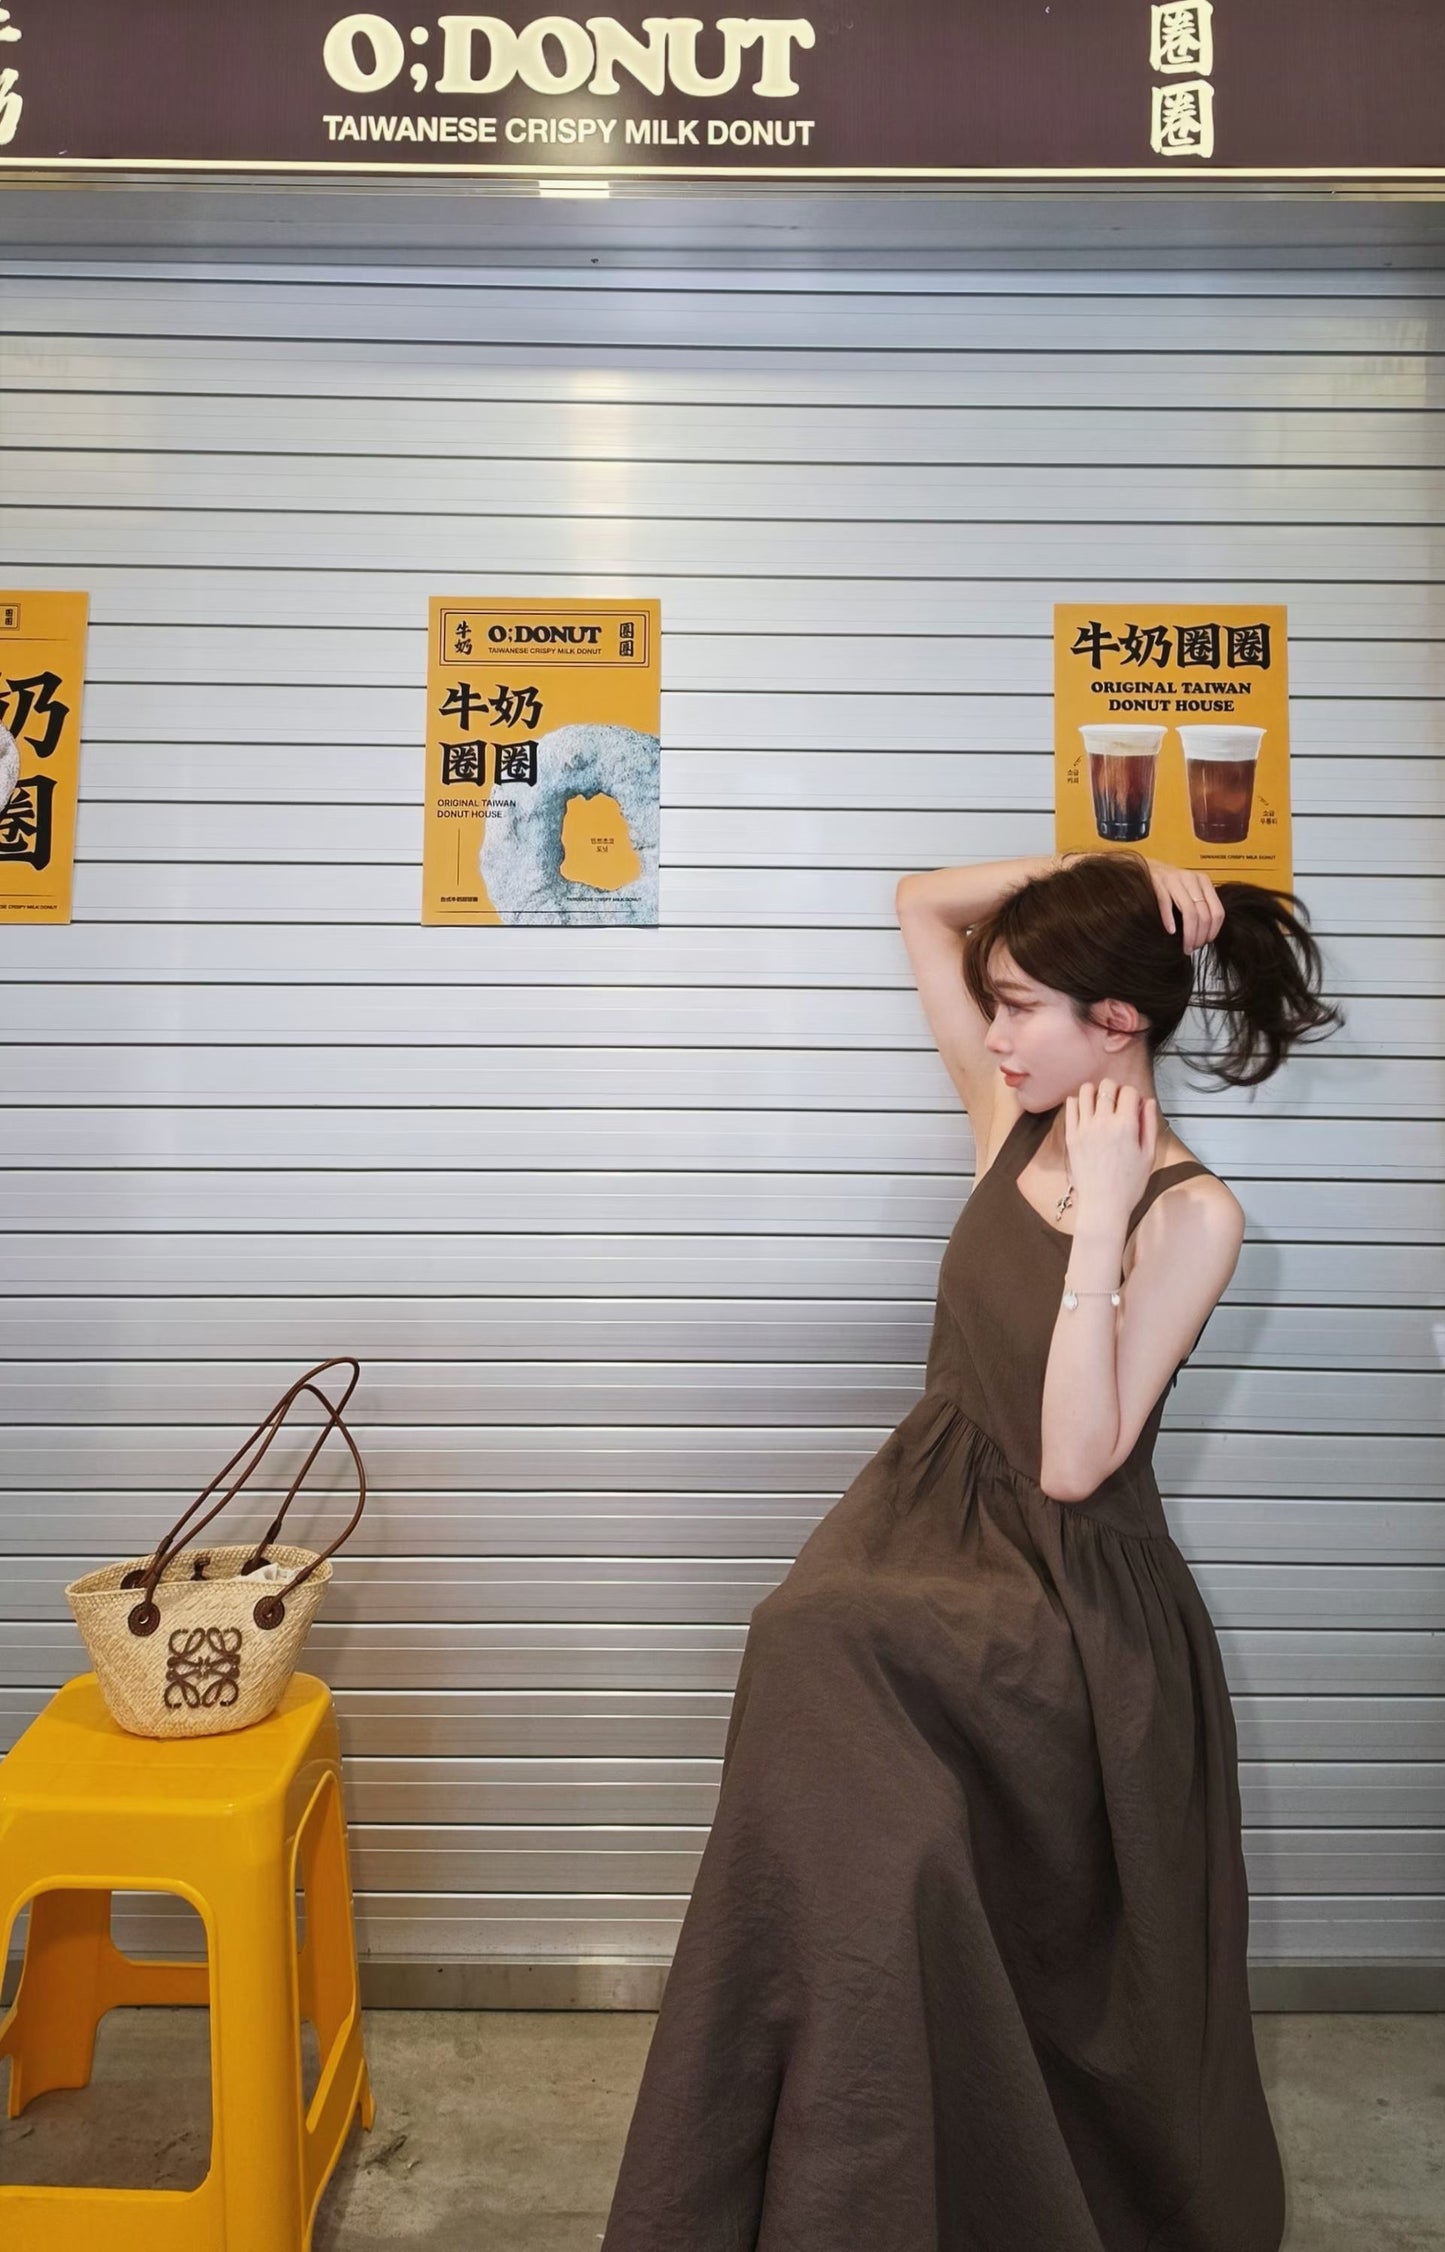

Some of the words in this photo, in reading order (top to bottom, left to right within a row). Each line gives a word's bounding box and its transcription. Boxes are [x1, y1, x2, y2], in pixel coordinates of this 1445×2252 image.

[323, 13, 816, 97] O;DONUT
[1149, 0, 1214, 158] 圈圈
[322, 114, 498, 143] TAIWANESE
[504, 117, 617, 145] CRISPY
[625, 118, 700, 145] MILK
[707, 119, 816, 146] DONUT
[454, 620, 473, 656] 牛奶
[488, 625, 602, 644] O;DONUT
[1070, 620, 1271, 670] 牛奶圈圈
[488, 647, 529, 655] TAIWANESE
[530, 647, 556, 655] CRISPY
[557, 647, 576, 655] MILK
[576, 647, 602, 656] DONUT
[1091, 681, 1178, 694] ORIGINAL
[1181, 682, 1252, 694] TAIWAN
[438, 682, 544, 731] 牛奶
[1109, 699, 1172, 712] DONUT
[1175, 699, 1236, 712] HOUSE
[438, 739, 540, 788] 圈圈
[436, 810, 470, 818] DONUT
[471, 810, 502, 819] HOUSE
[437, 799, 479, 808] ORIGINAL
[481, 799, 517, 809] TAIWAN
